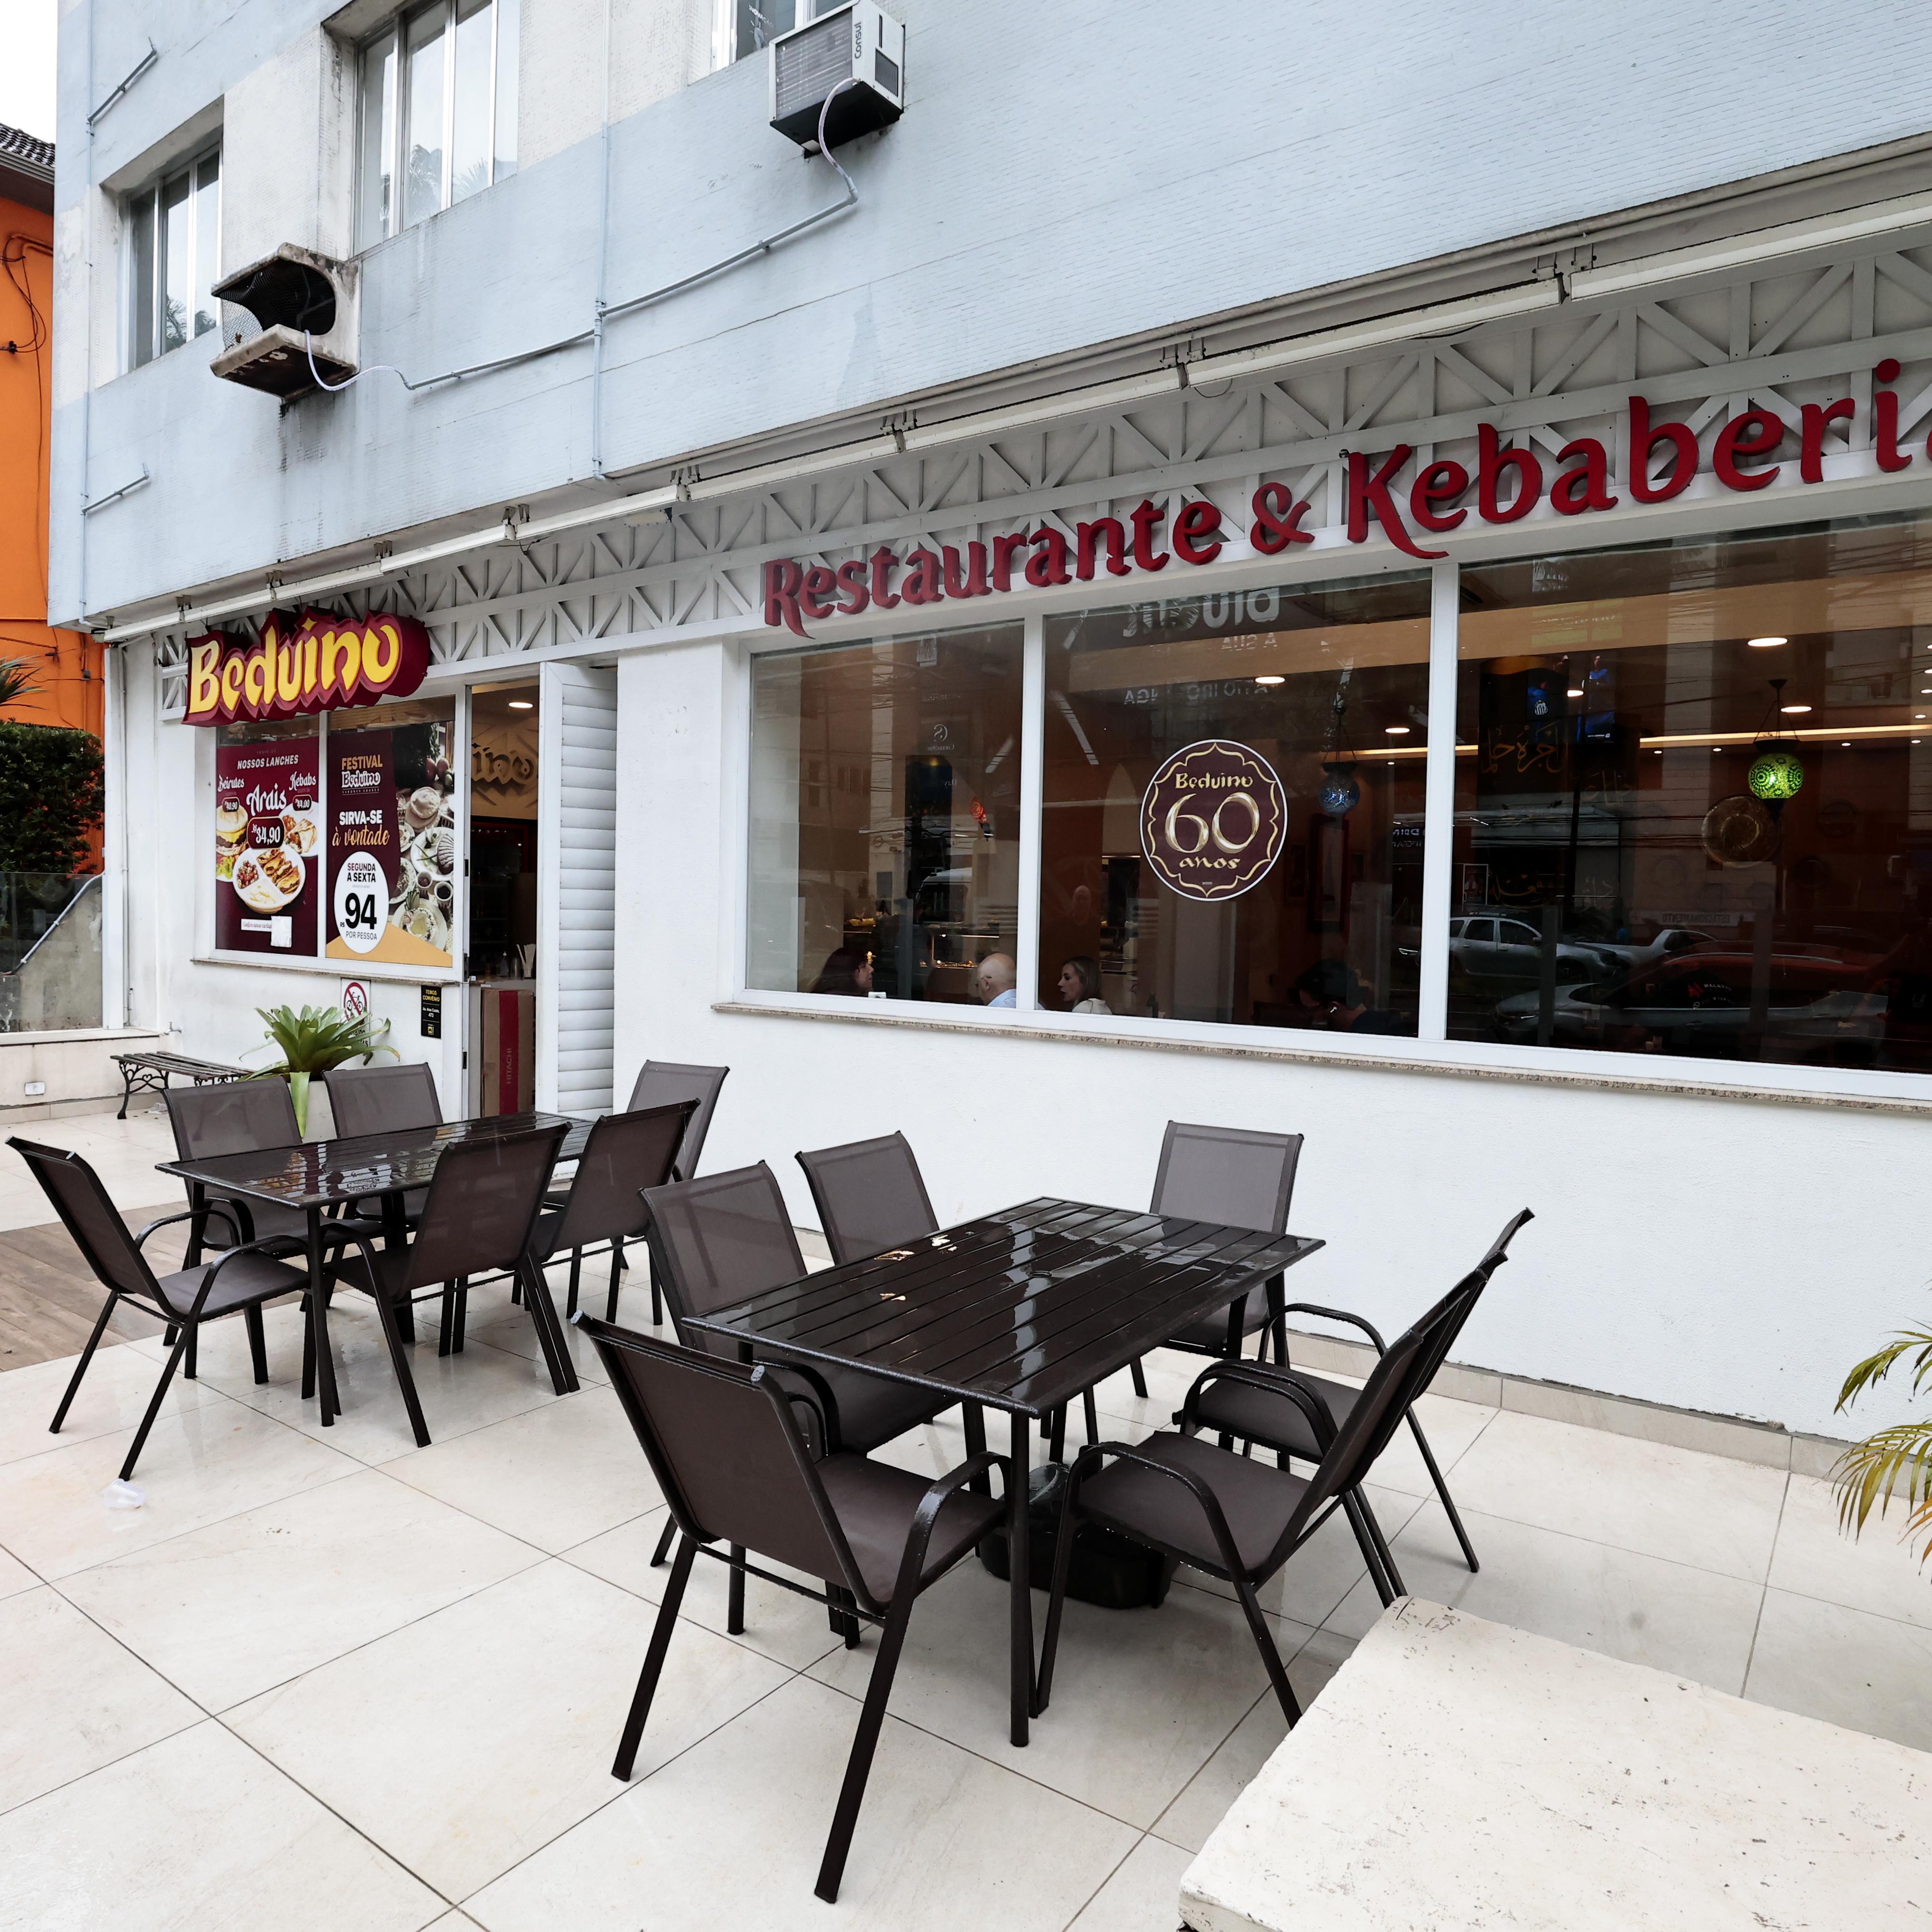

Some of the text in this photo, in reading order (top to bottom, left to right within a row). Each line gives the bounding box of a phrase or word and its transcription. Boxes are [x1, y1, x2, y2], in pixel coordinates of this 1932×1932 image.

[765, 358, 1932, 639] Restaurante & Kebaberi
[189, 617, 400, 714] Beduino
[237, 754, 299, 769] NOSSOS LANCHES
[341, 754, 383, 770] FESTIVAL
[217, 774, 244, 792] Beirutes
[289, 771, 316, 791] Kebabs
[341, 770, 381, 788] Beduino
[1175, 772, 1253, 789] Beduino
[246, 782, 287, 816] Arais
[339, 810, 383, 825] SIRVA-SE
[1165, 792, 1260, 854] 60
[332, 824, 390, 846] à vontade
[347, 863, 376, 871] SEGUNDA
[1179, 856, 1241, 869] anos
[347, 872, 376, 882] A SEXTA
[345, 893, 377, 930] 94
[357, 932, 377, 940] PESSOA
